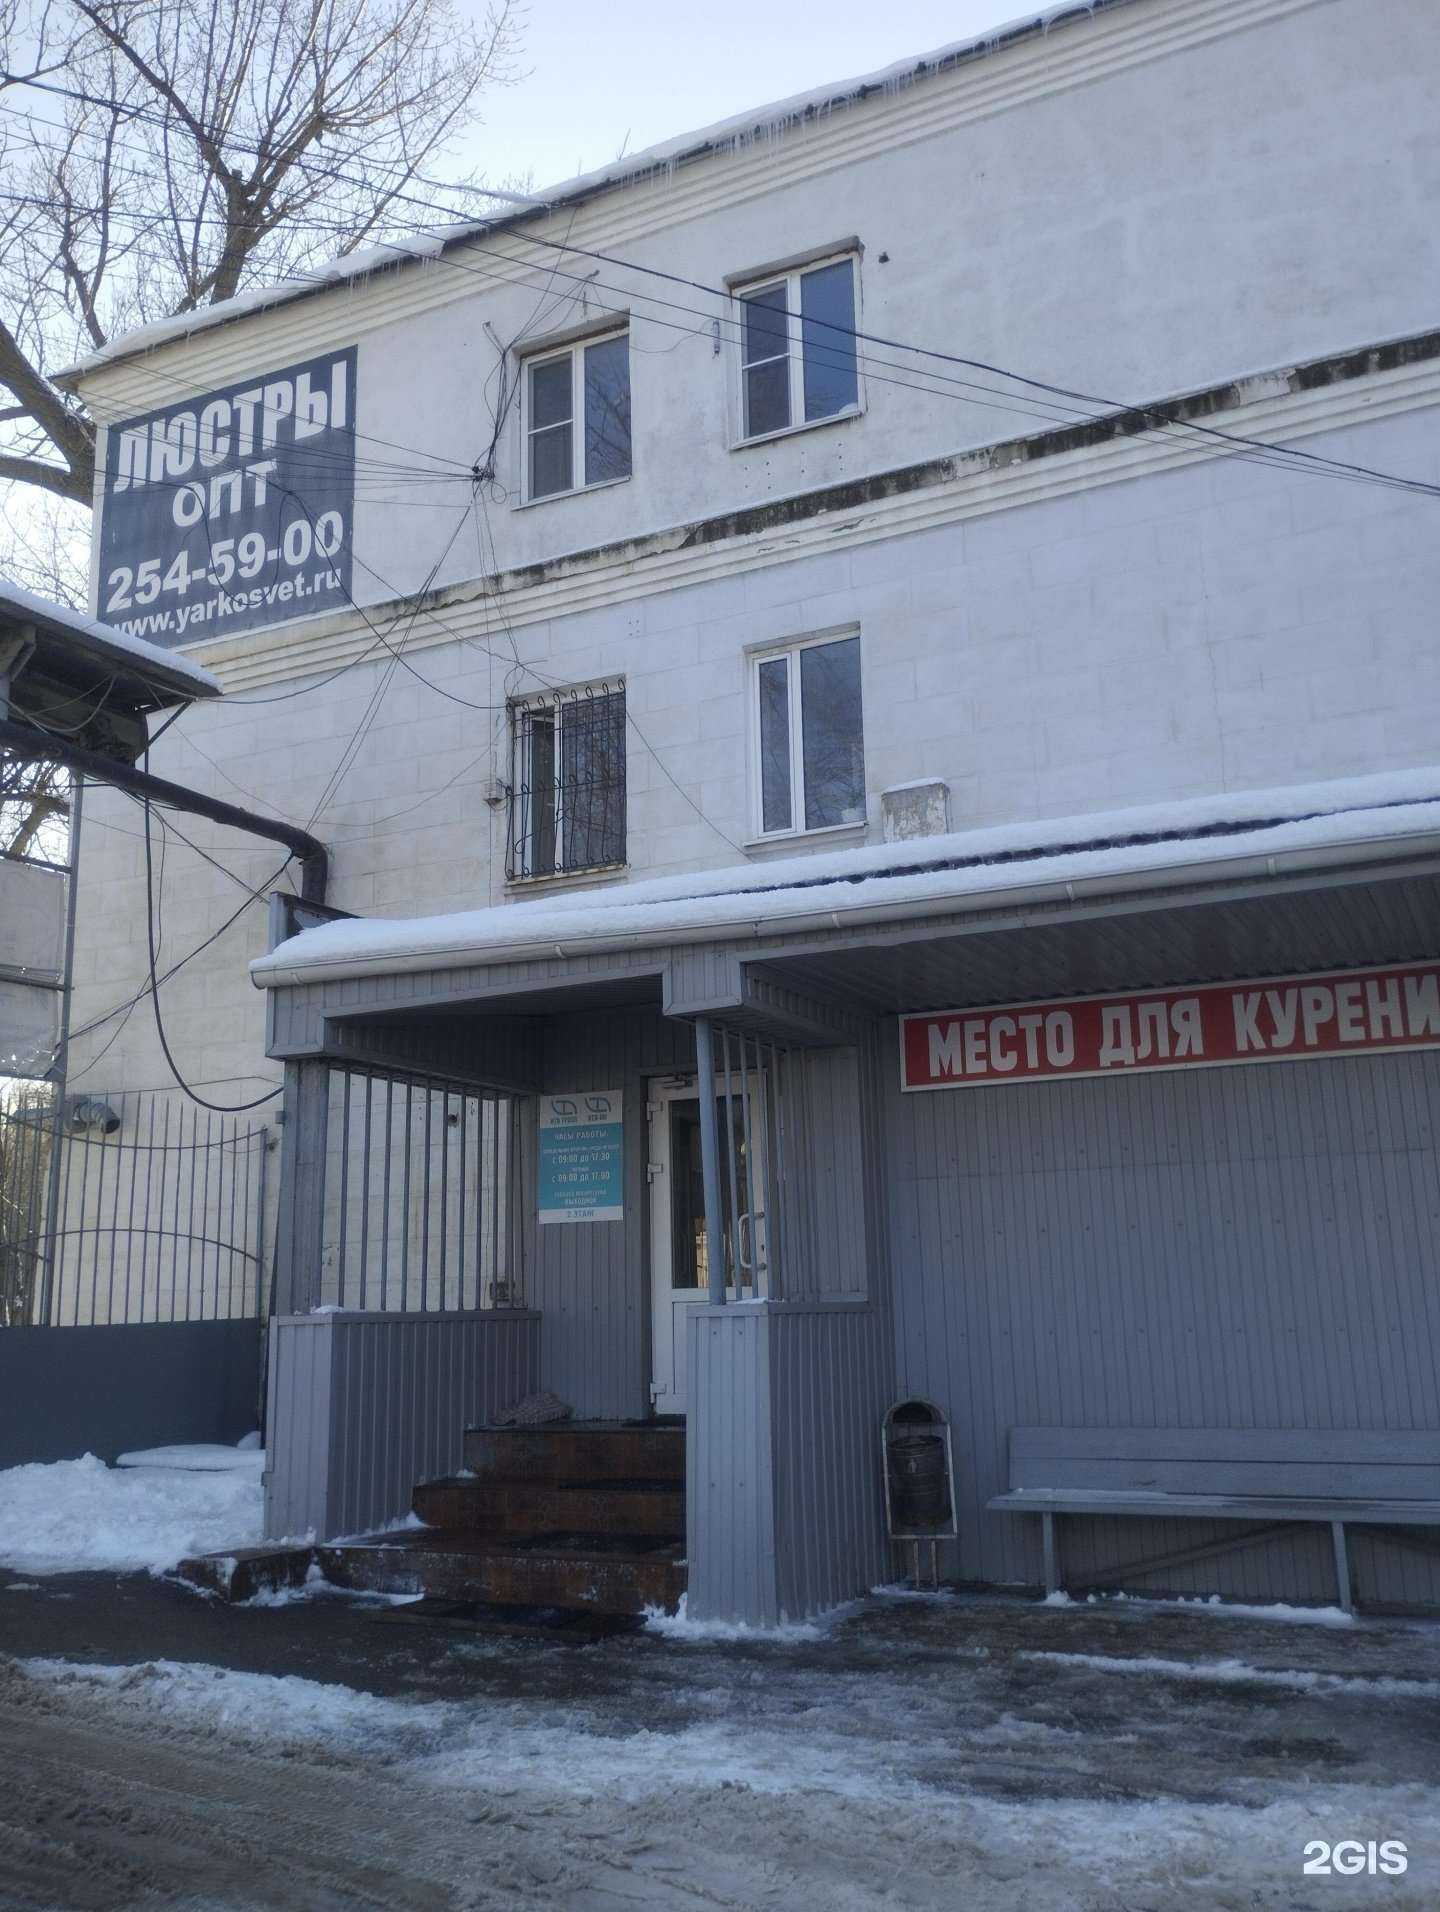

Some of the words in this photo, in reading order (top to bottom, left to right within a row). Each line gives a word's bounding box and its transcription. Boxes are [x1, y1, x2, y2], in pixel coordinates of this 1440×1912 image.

[113, 360, 347, 494] ЛЮСТРЫ
[172, 458, 278, 527] ОПТ
[106, 510, 343, 613] 254-59-00
[927, 1011, 1074, 1078] МЕСТО
[1099, 998, 1205, 1068] ДЛЯ
[1231, 974, 1440, 1052] КУРЕНИ
[591, 1152, 610, 1161] 17:30
